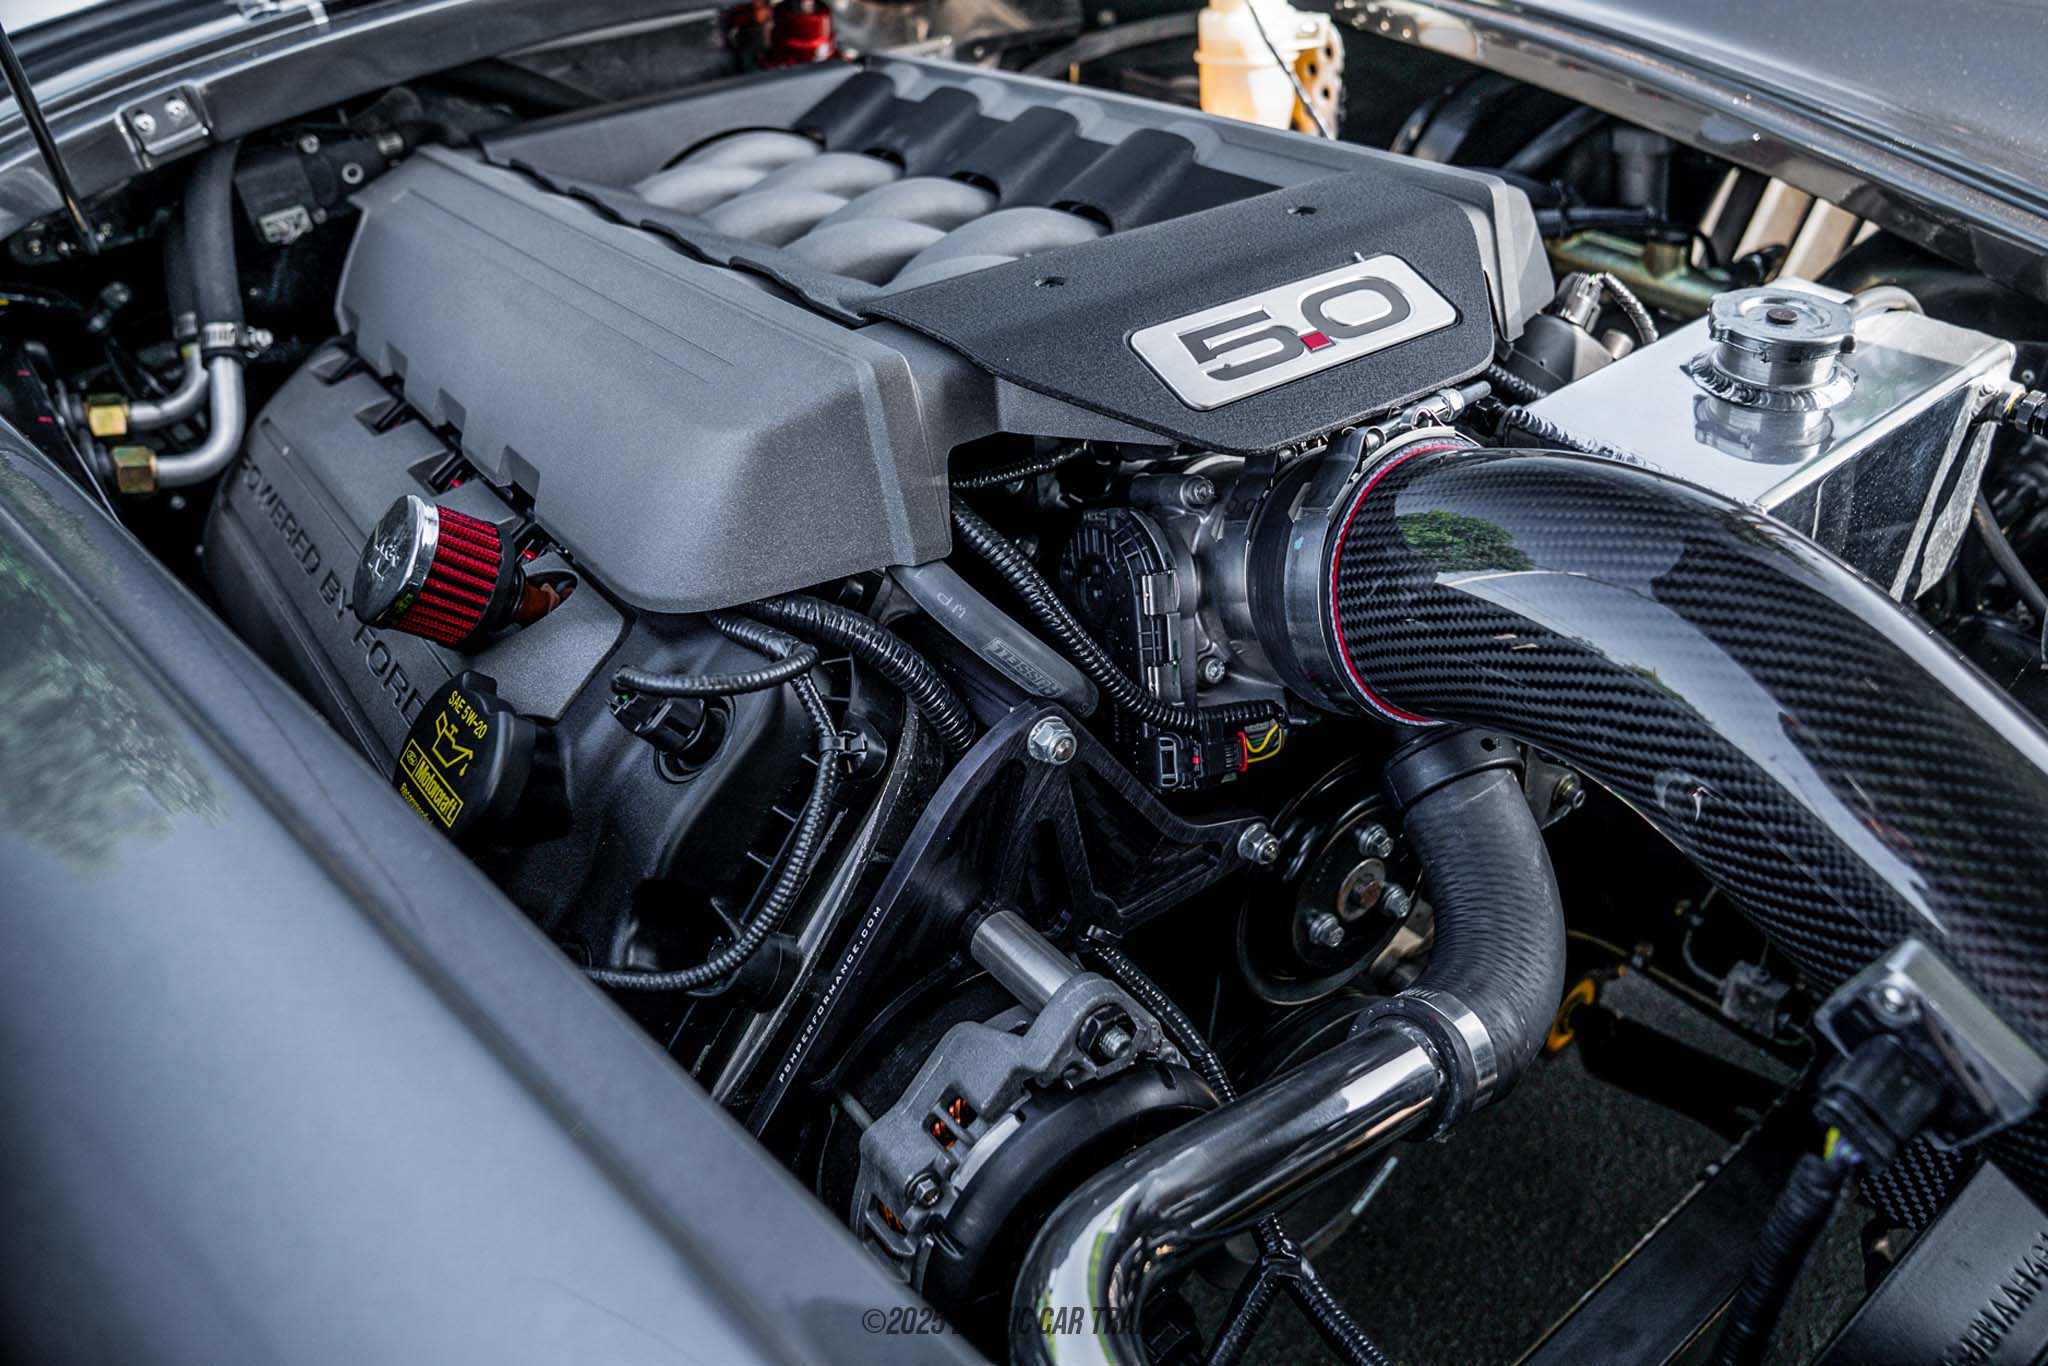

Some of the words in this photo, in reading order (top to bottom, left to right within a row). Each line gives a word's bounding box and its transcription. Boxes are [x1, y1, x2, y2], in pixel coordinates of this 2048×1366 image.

[1176, 276, 1412, 382] 5.0
[448, 690, 467, 714] SAE
[461, 704, 488, 739] 5W-20
[414, 760, 459, 822] Motorcraft
